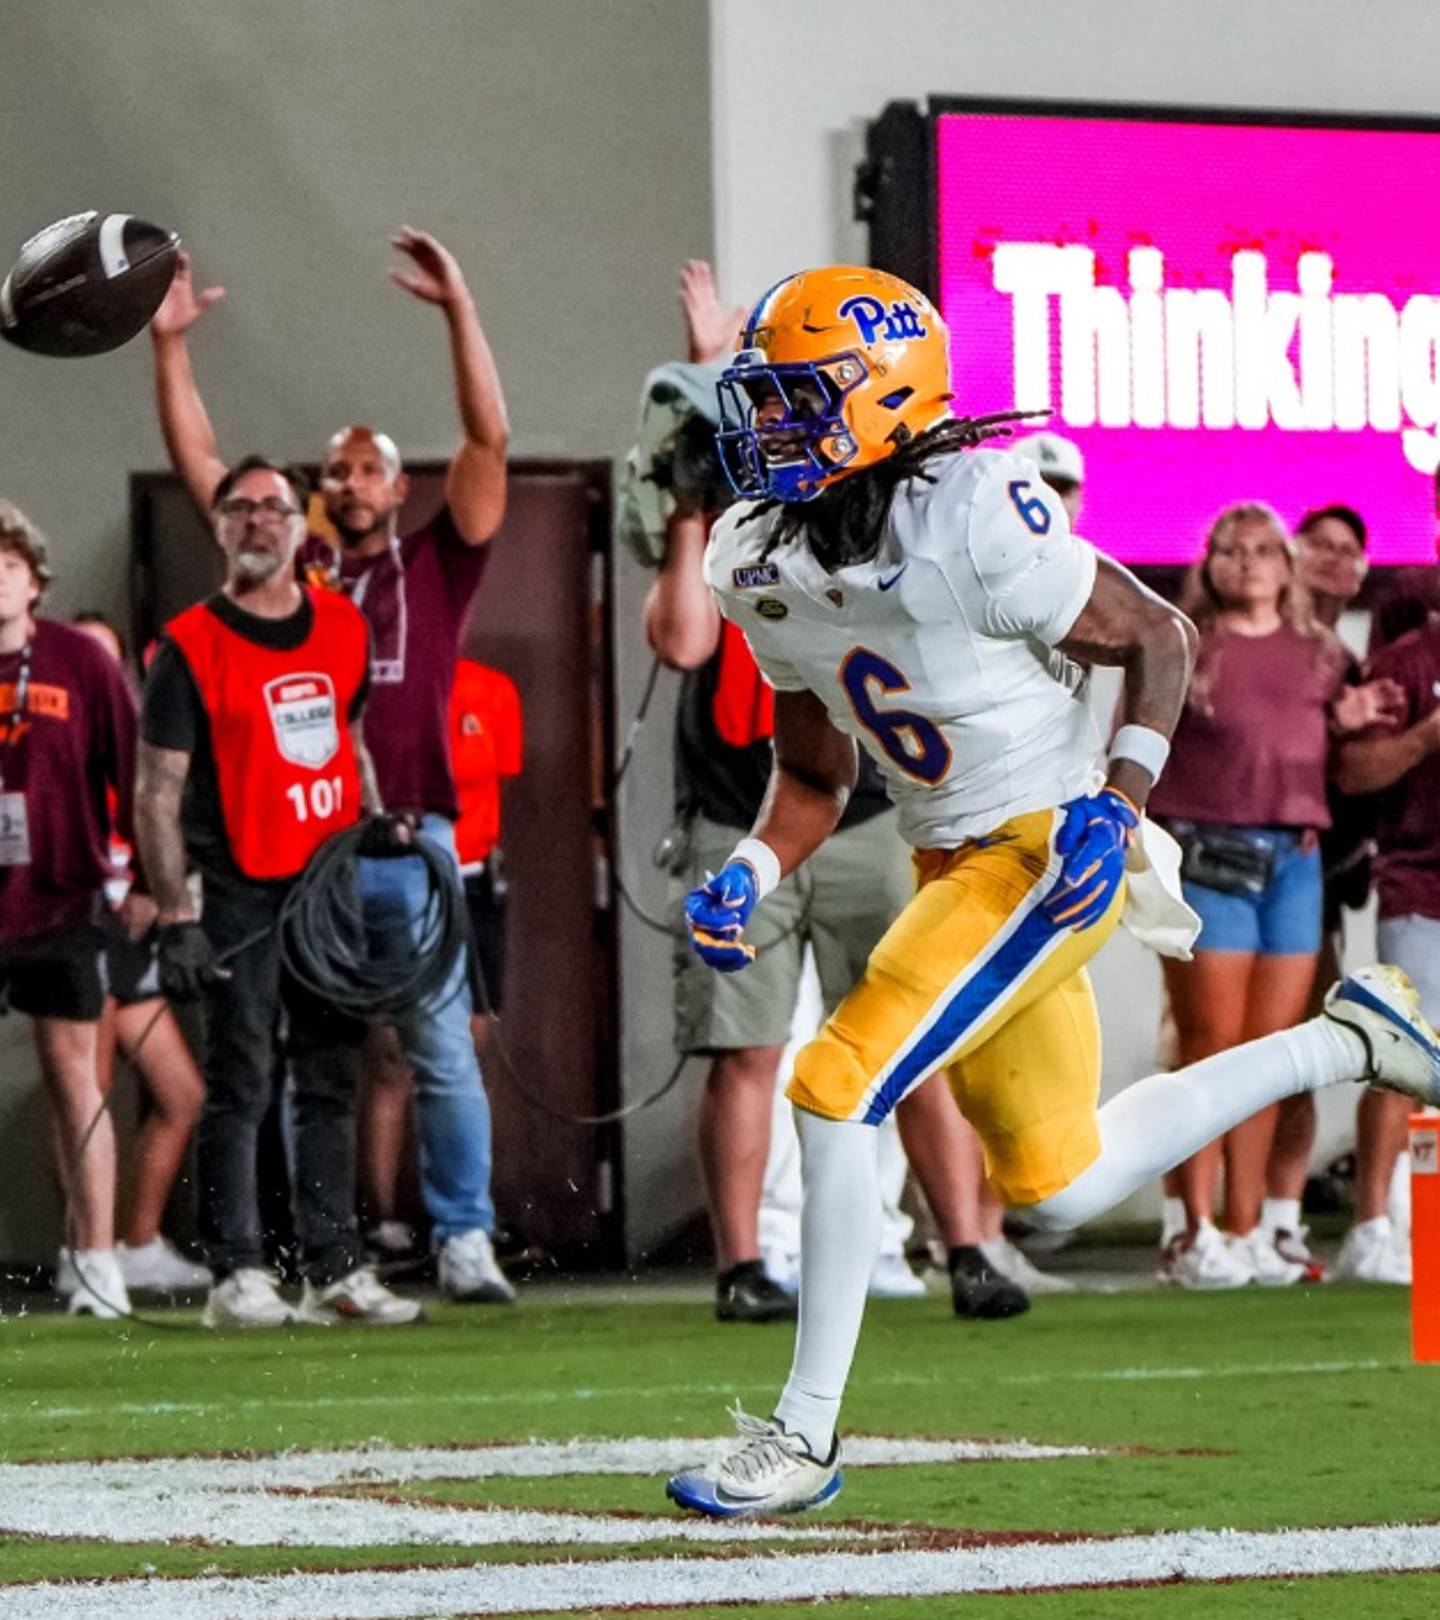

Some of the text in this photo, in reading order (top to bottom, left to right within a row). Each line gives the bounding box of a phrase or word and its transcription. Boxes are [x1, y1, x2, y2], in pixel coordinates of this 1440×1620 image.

[838, 294, 927, 344] Pitt
[1008, 479, 1052, 535] 6
[838, 646, 954, 786] 6
[286, 775, 344, 822] 101
